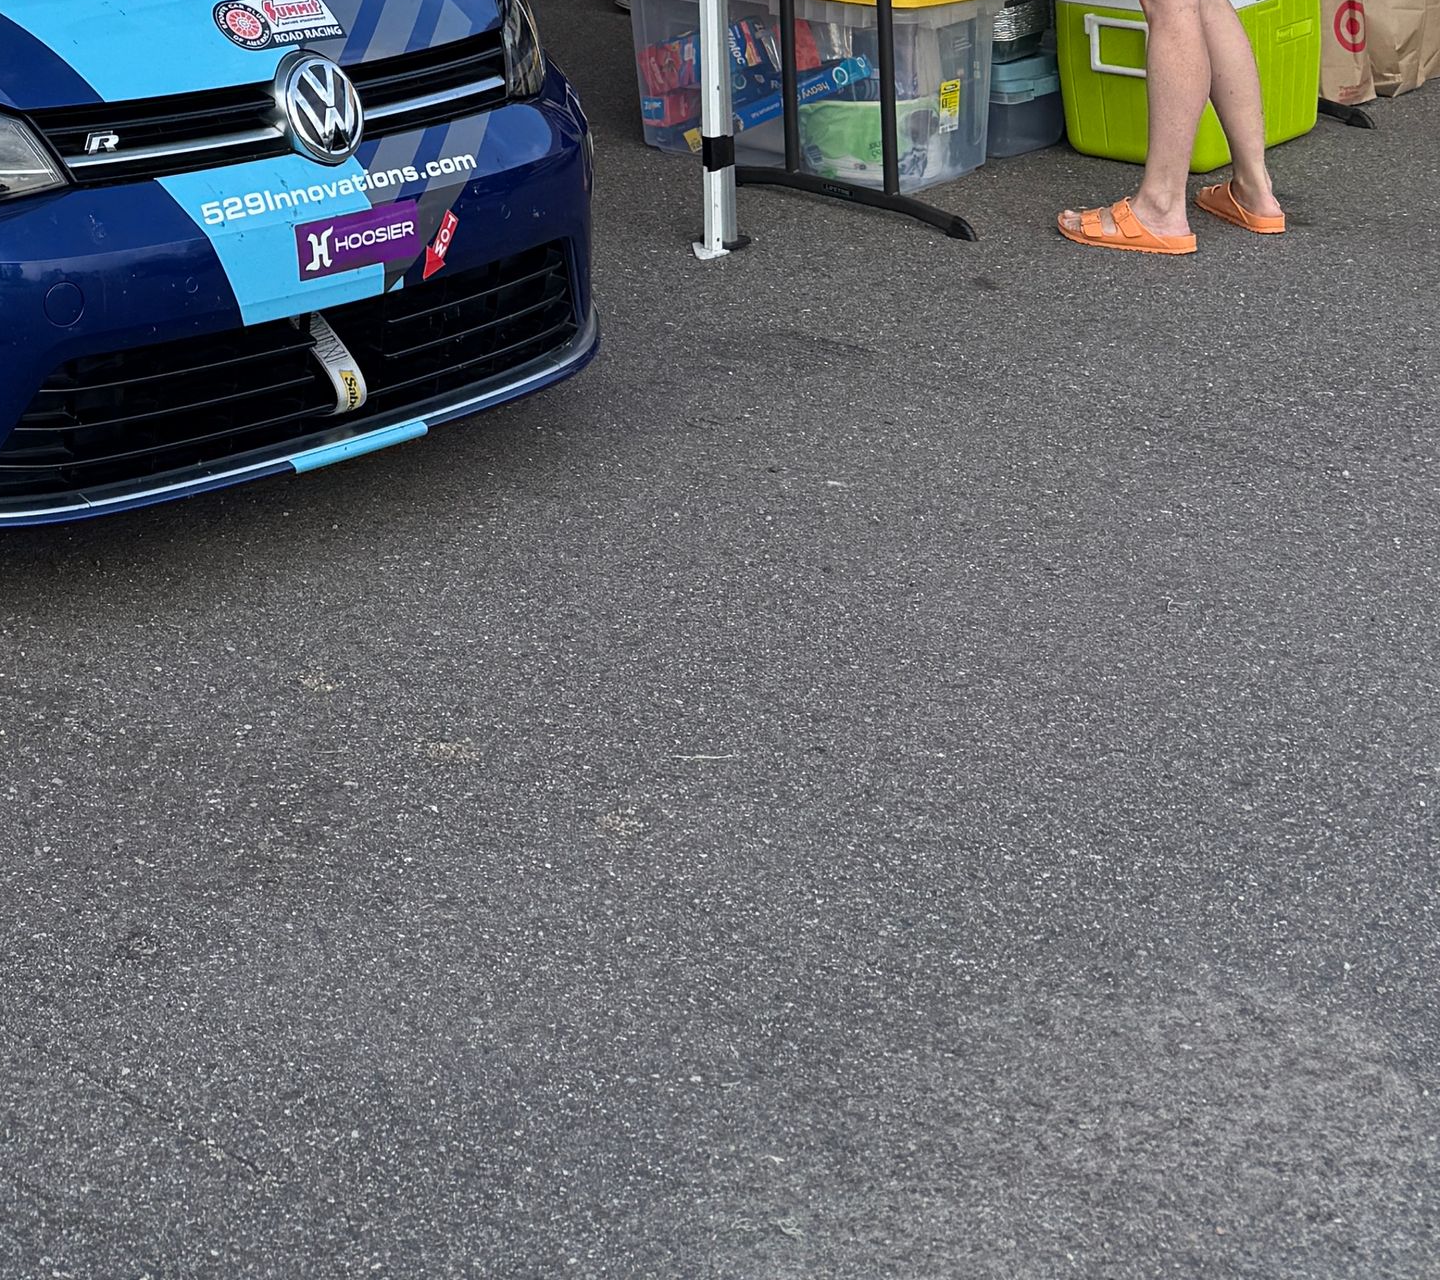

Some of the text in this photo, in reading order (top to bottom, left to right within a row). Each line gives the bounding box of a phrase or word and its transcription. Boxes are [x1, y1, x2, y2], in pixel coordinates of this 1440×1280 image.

[274, 25, 343, 44] ROAD RACING
[84, 129, 120, 155] R
[201, 149, 478, 227] 529Innovations.com
[334, 219, 415, 254] HOOSIER
[432, 213, 460, 258] TOW
